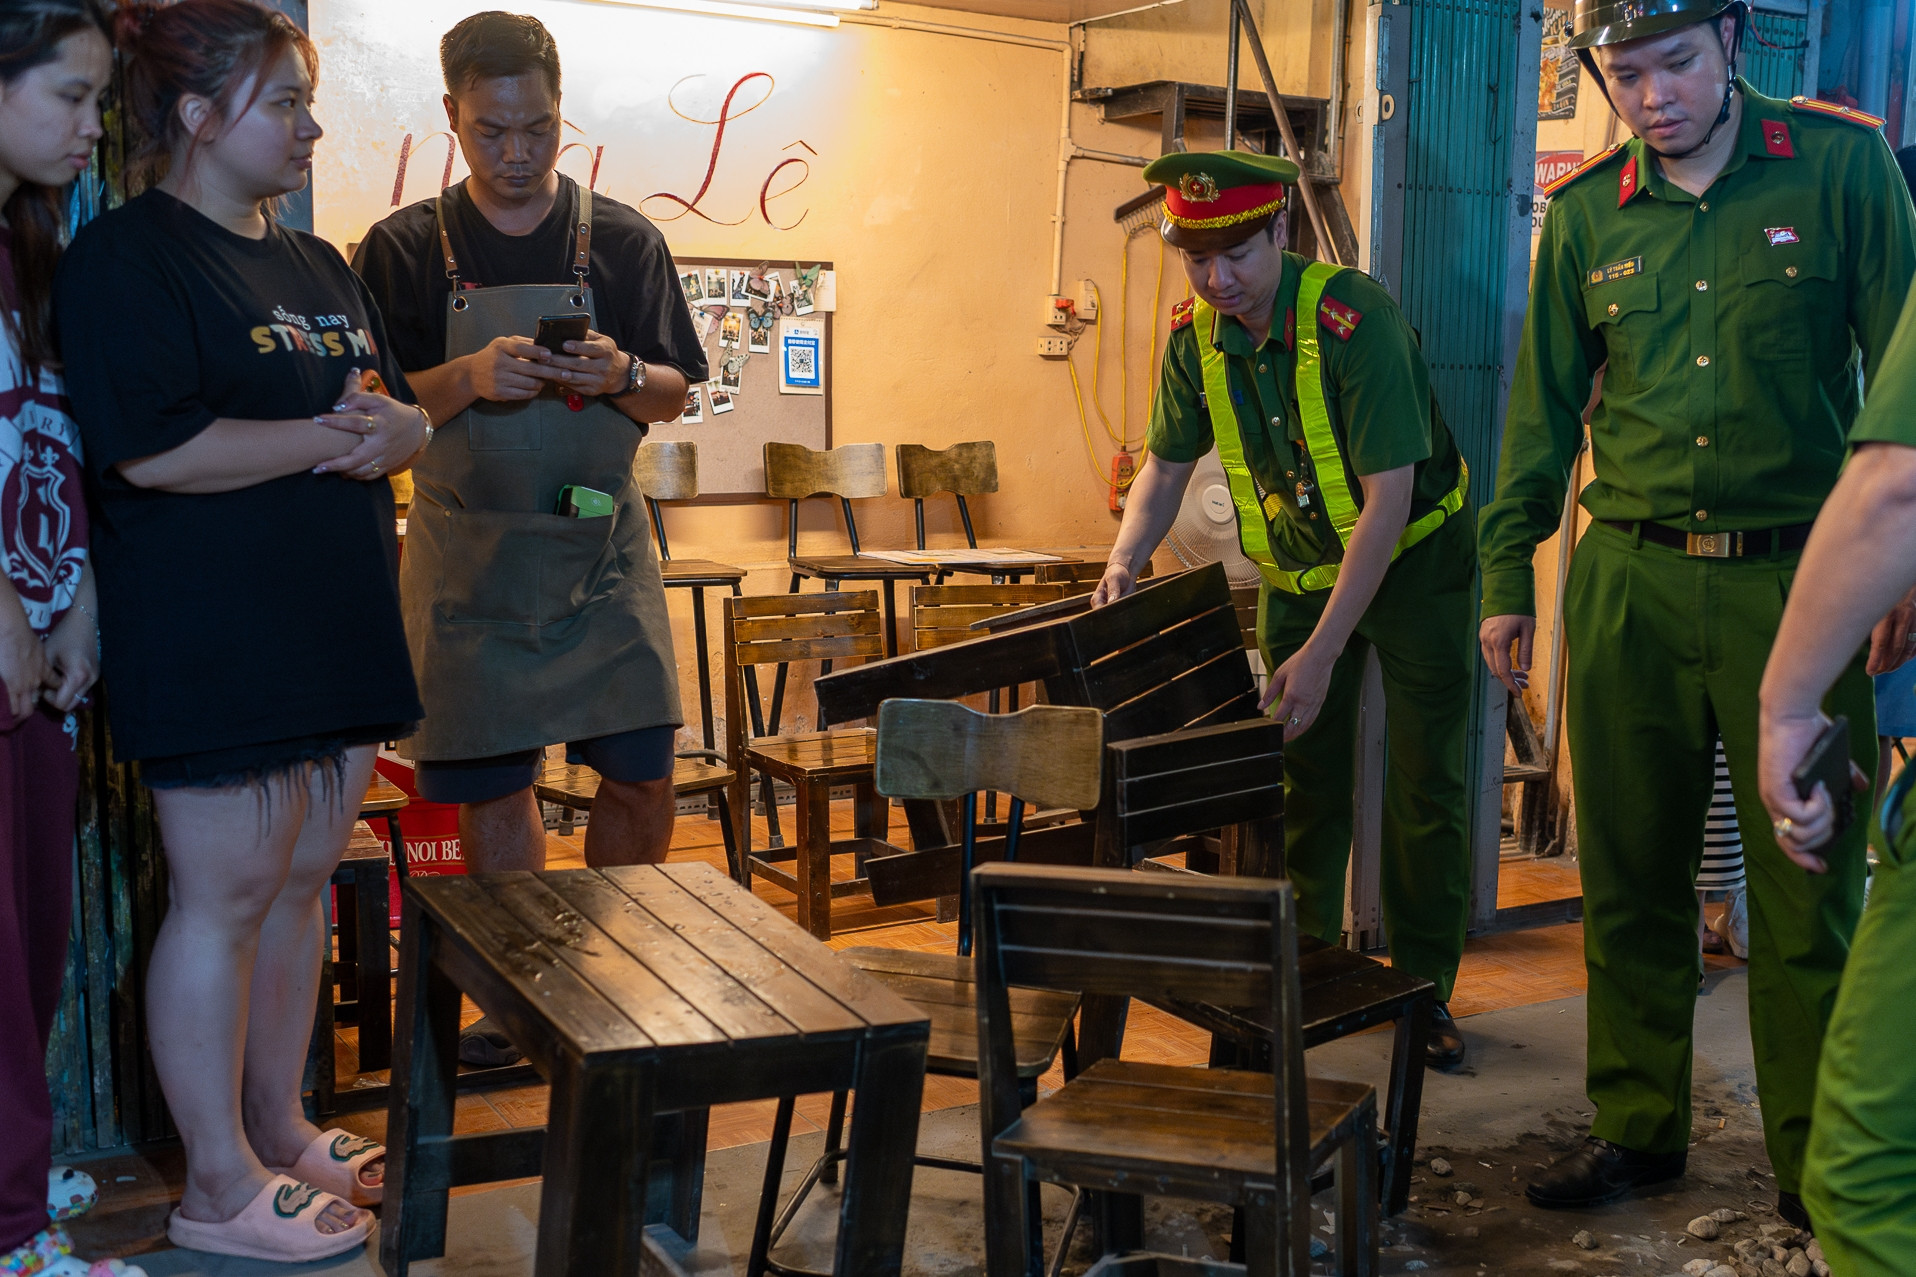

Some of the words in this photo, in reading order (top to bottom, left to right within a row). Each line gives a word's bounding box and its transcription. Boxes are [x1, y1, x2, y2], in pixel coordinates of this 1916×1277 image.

[639, 71, 818, 231] Lê
[315, 313, 349, 328] nay
[250, 323, 345, 357] STRESS
